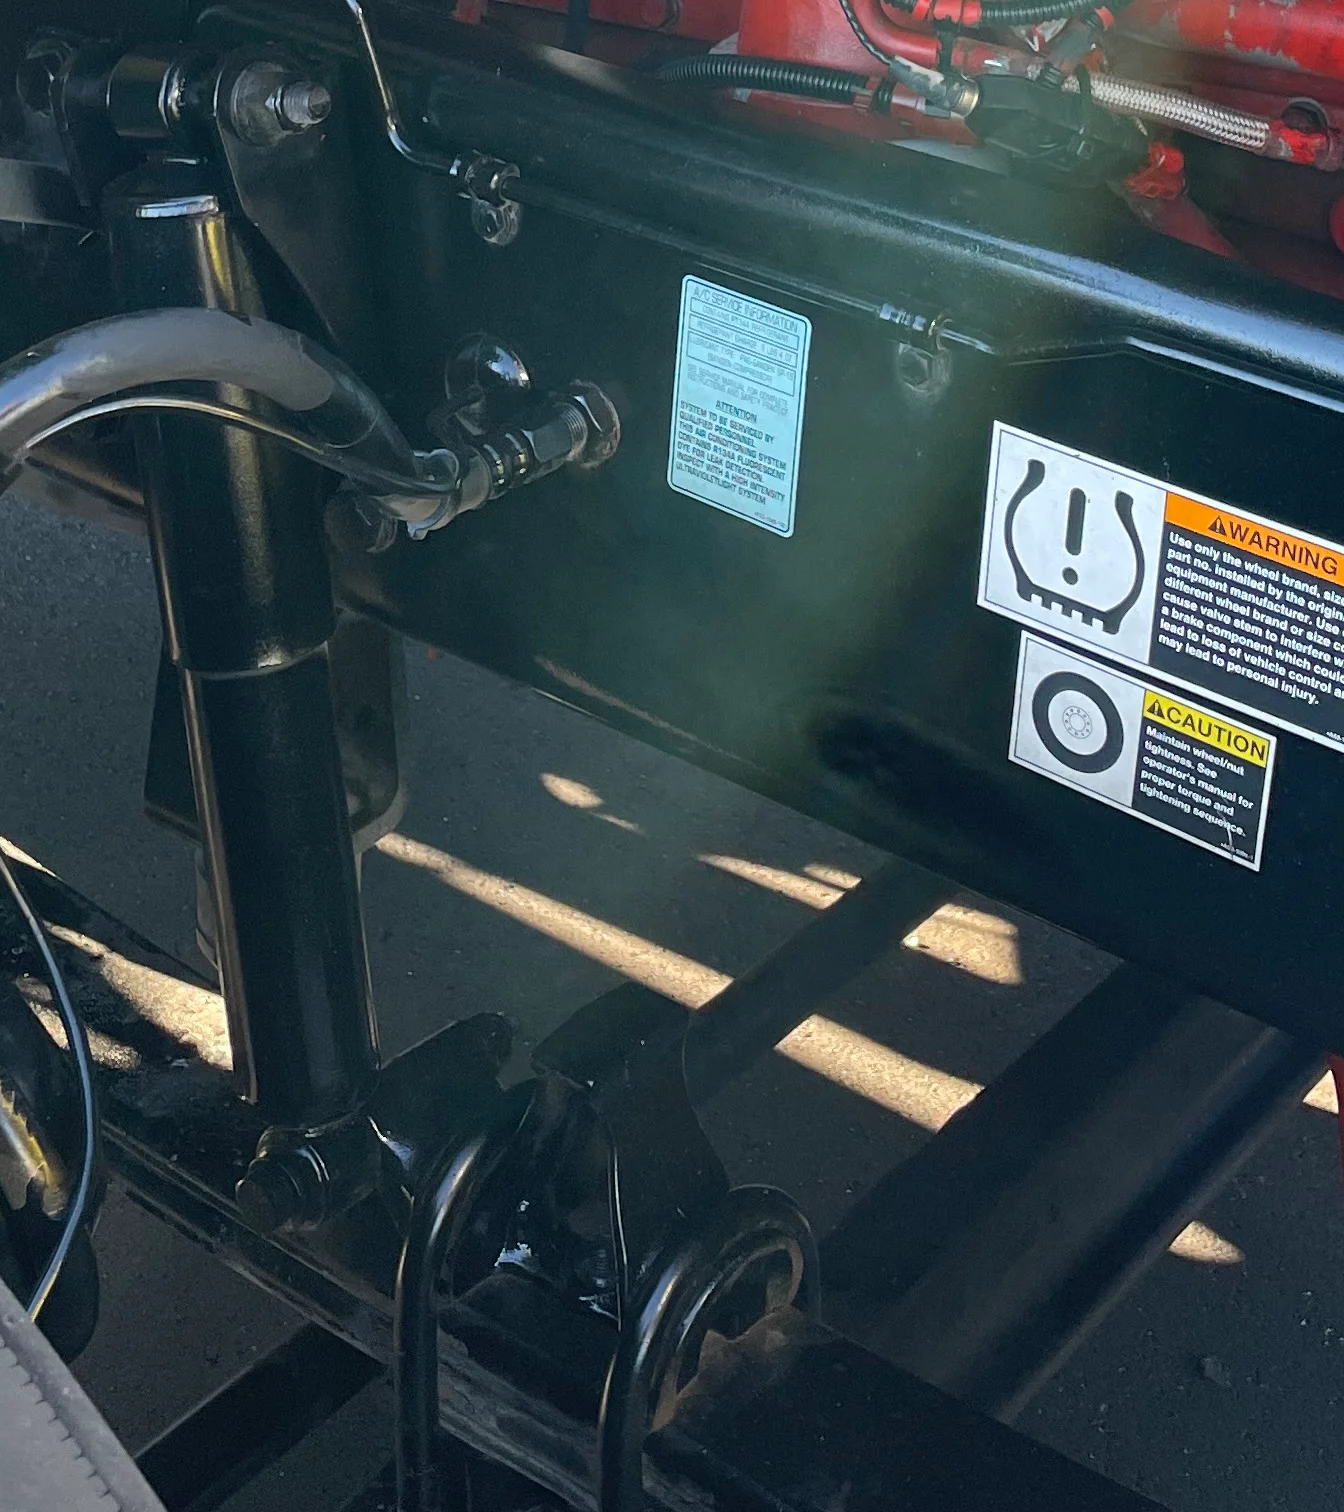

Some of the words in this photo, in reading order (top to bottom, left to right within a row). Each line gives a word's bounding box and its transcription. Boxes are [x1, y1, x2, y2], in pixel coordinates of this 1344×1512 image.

[711, 291, 743, 314] SERVICE
[743, 303, 798, 334] INFORMATION
[679, 399, 707, 419] SYSTEM
[708, 410, 718, 424] TO
[718, 414, 728, 428] BE
[728, 418, 763, 442] SERVICED
[764, 432, 774, 446] BY
[715, 398, 758, 424] ATTENTION
[678, 419, 694, 434] THIS
[694, 425, 706, 439] AIR
[707, 431, 757, 460] CONDITIONING
[757, 451, 787, 472] SYSTEM
[1169, 531, 1192, 549] Use
[1194, 543, 1219, 560] only
[1222, 551, 1242, 567] the
[1244, 561, 1279, 581] wheel
[1281, 573, 1320, 598] brand,
[1229, 521, 1337, 575] WARNING
[1165, 562, 1227, 592] equipment
[1229, 586, 1312, 624] manufacturer.
[1315, 616, 1339, 635] Use
[1167, 548, 1191, 564] part
[1193, 557, 1212, 572] no.
[1214, 563, 1265, 591] installed
[1267, 582, 1283, 599] by
[1285, 590, 1305, 606] the
[1161, 605, 1169, 615] a
[1171, 607, 1204, 629] brake
[1205, 623, 1272, 655] component
[1275, 649, 1311, 670] which
[1162, 591, 1197, 611] cause
[1200, 605, 1231, 624] valve
[1233, 618, 1262, 636] stem
[1265, 628, 1278, 642] to
[1280, 634, 1331, 662] interfere
[1164, 576, 1213, 602] different
[1215, 596, 1250, 616] wheel
[1252, 608, 1288, 630] brand
[1289, 624, 1304, 636] or
[1305, 630, 1331, 647] size
[1158, 634, 1183, 652] may
[1185, 642, 1210, 661] lead
[1212, 653, 1224, 667] to
[1226, 661, 1278, 688] personal
[1280, 680, 1318, 704] injury.
[1159, 618, 1184, 636] lead
[1186, 628, 1199, 642] to
[1201, 633, 1226, 652] loss
[1228, 647, 1241, 658] of
[1243, 652, 1286, 676] vehicle
[1288, 670, 1331, 693] control
[1144, 740, 1194, 769] tightness.
[1196, 762, 1217, 778] See
[1146, 725, 1190, 752] Maintain
[1192, 747, 1244, 775] wheel/nut
[1166, 706, 1265, 760] CAUTION
[1139, 782, 1190, 813] tightening
[1140, 769, 1176, 789] proper
[1177, 784, 1211, 806] torque
[1213, 801, 1234, 816] and
[1142, 756, 1195, 784] operator's
[1197, 779, 1236, 802] manual
[1237, 795, 1254, 809] for
